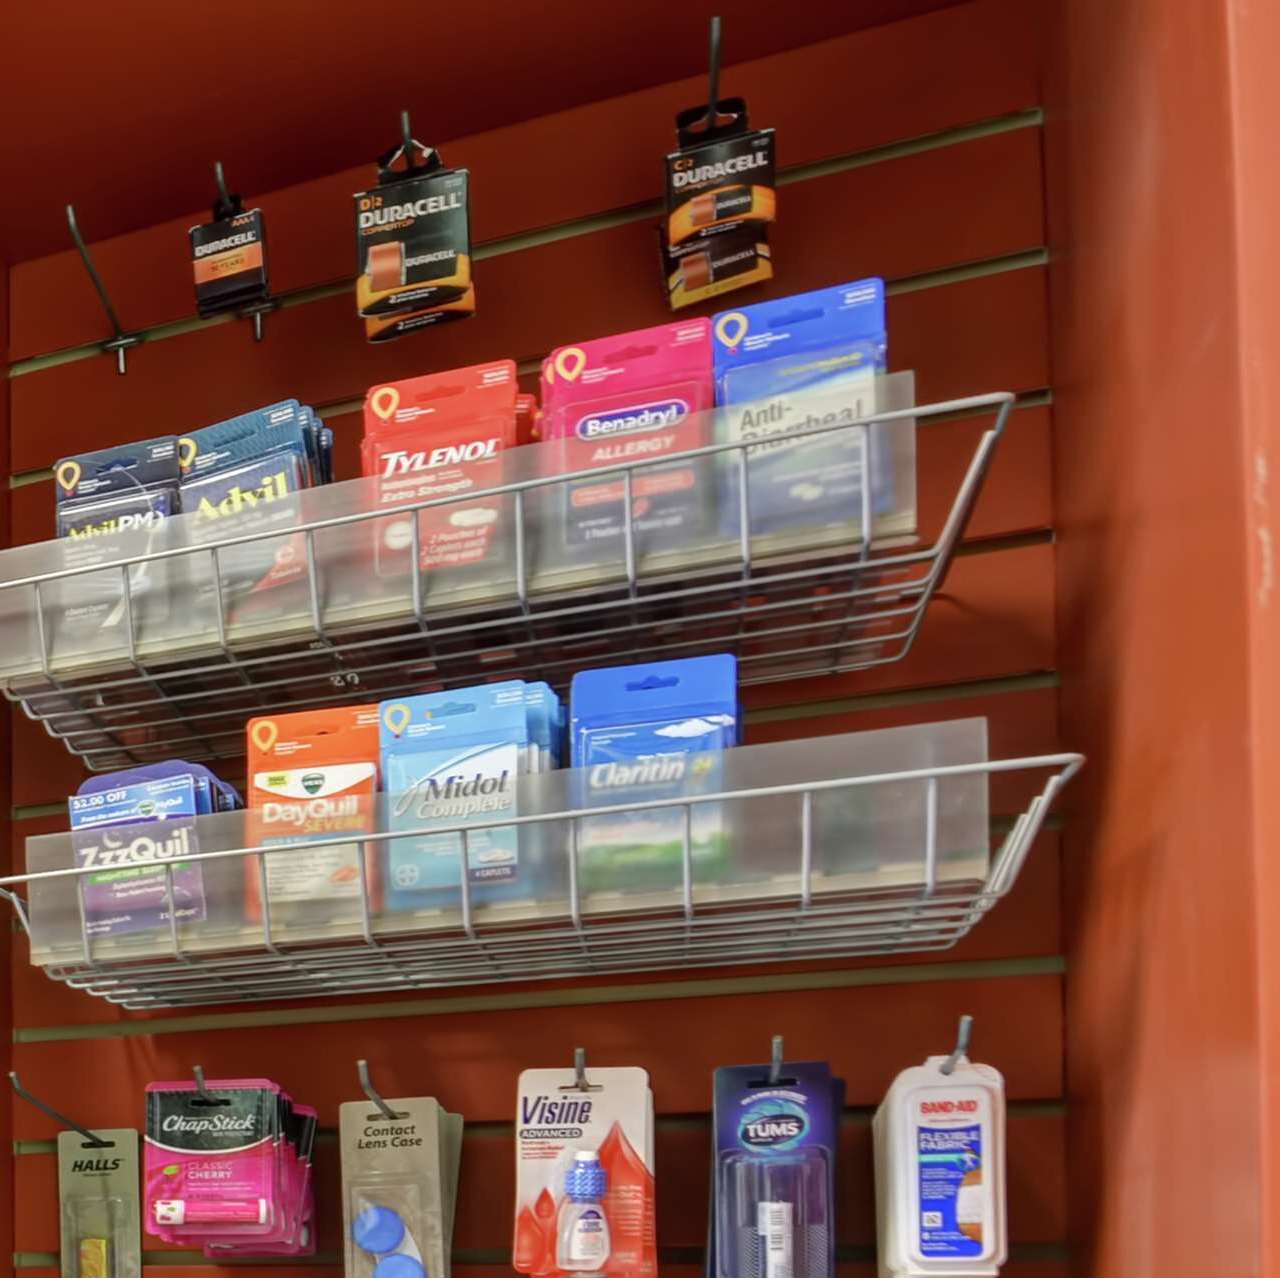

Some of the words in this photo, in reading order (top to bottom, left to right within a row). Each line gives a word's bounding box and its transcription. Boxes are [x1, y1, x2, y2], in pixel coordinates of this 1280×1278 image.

[672, 151, 769, 188] DURACELL
[359, 191, 462, 229] DURACELL
[195, 230, 257, 257] DURACELL
[405, 249, 456, 267] DURACELL
[586, 405, 678, 438] Benadryl
[739, 400, 793, 432] Anti-
[380, 438, 501, 481] TYLENOL
[592, 435, 677, 462] ALLERGY
[191, 471, 291, 524] Advil
[382, 490, 416, 503] Extra
[417, 479, 473, 497] Strength
[590, 752, 686, 788] Claritin
[106, 790, 128, 802] OFF
[424, 769, 509, 802] Midol
[261, 795, 359, 826] DayQuil
[416, 796, 513, 819] Complete
[303, 816, 366, 834] SEVERE
[79, 827, 192, 869] ZzzQuil
[521, 1096, 593, 1125] Visine
[920, 1099, 979, 1115] BAND-AID
[161, 1113, 256, 1133] ChapStick
[363, 1124, 417, 1138] Contact
[520, 1128, 581, 1139] ADVANCED
[746, 1121, 801, 1139] TUMS
[357, 1138, 388, 1150] Lens
[390, 1136, 423, 1148] Case
[920, 1140, 973, 1152] FABRIC
[921, 1130, 979, 1142] FLEXIBLE
[71, 1158, 121, 1173] HALLS
[187, 1161, 233, 1171] CLASSIC
[187, 1170, 232, 1180] CHERRY
